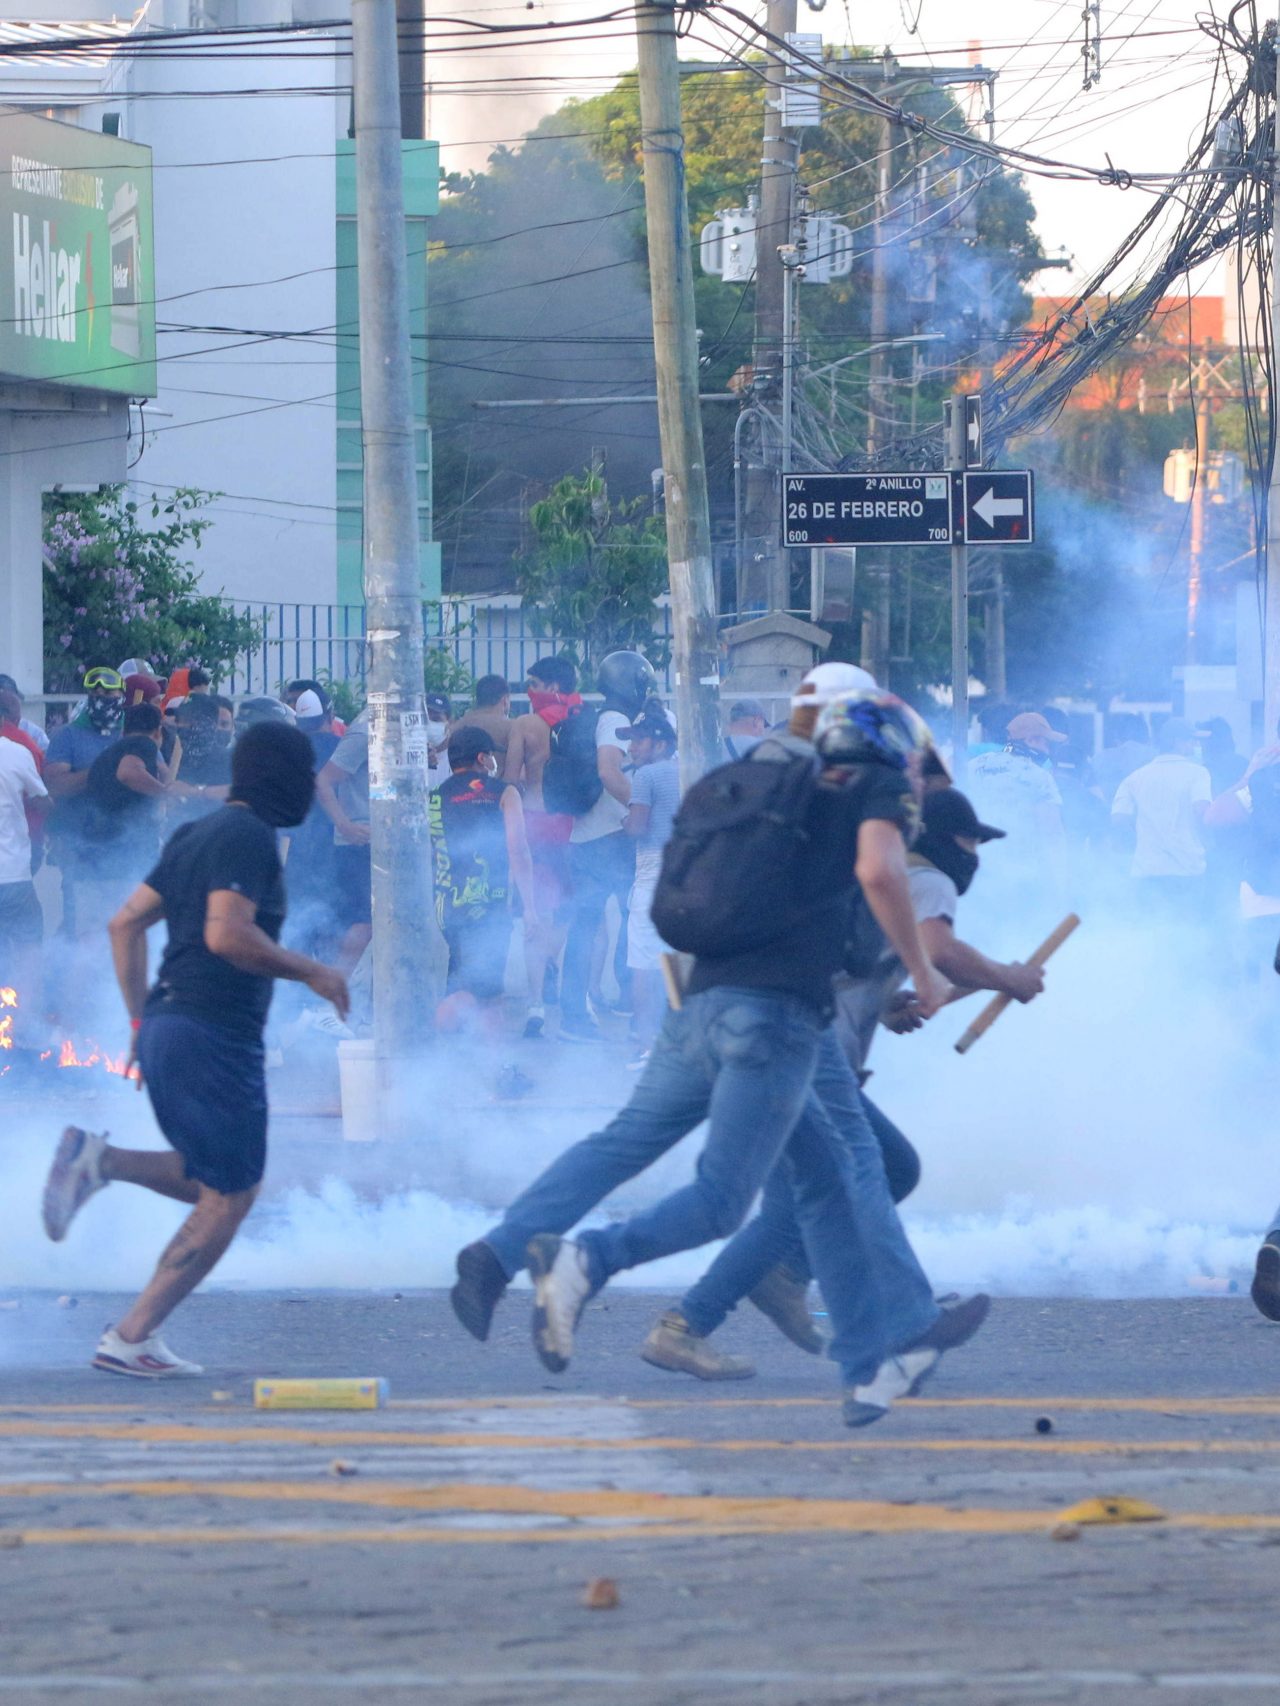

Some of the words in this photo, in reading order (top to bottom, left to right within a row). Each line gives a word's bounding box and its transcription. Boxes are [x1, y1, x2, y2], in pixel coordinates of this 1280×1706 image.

[12, 154, 63, 200] REPRESENTANTE
[95, 176, 104, 210] DE
[12, 212, 81, 343] Heliar
[788, 480, 806, 492] AV.
[879, 478, 922, 490] ANILLO
[788, 503, 807, 519] 26
[812, 502, 836, 519] DE
[841, 501, 923, 518] FEBRERO
[788, 531, 808, 543] 600
[928, 528, 948, 540] 700
